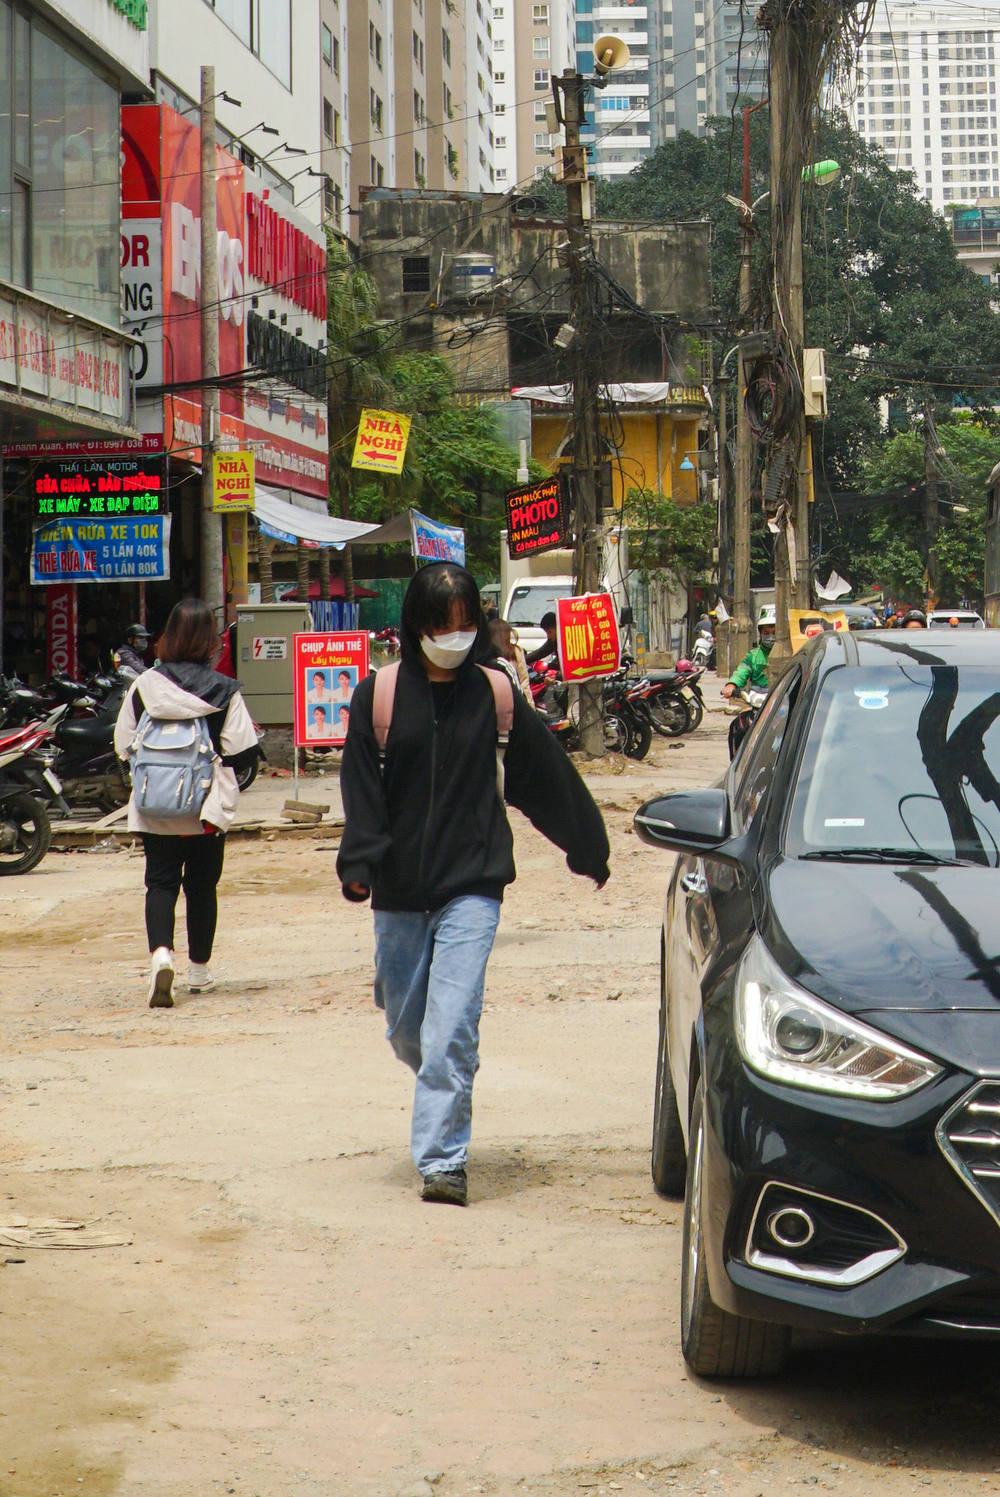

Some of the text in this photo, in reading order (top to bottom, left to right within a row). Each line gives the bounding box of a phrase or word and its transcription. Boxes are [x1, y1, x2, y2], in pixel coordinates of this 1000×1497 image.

[171, 201, 244, 327] ENOS
[365, 418, 402, 435] NHÀ
[145, 438, 159, 448] 116
[359, 434, 404, 452] NGHỈ
[60, 462, 138, 473] THÁI LAN MOTOR
[219, 458, 248, 474] NHÀ
[216, 473, 250, 490] NGHỈ
[39, 499, 54, 513] XE
[56, 495, 81, 513] MÁY
[89, 498, 104, 512] XE
[107, 497, 130, 514] ĐẠP
[132, 493, 159, 513] ĐIỆN
[511, 497, 558, 530] PHOTO
[78, 521, 106, 541] RỬA
[110, 525, 128, 540] XE
[133, 524, 159, 540] 10K
[512, 531, 520, 542] IN
[103, 546, 109, 558] 5
[136, 544, 158, 557] 40K
[83, 550, 97, 572] XE
[100, 563, 112, 576] 10
[138, 562, 158, 575] 80K
[301, 638, 362, 655] CHỤP ẢNH THẺ
[565, 617, 588, 661] BÚN
[311, 655, 352, 666] Lấy Ngay
[601, 652, 616, 662] CUA
